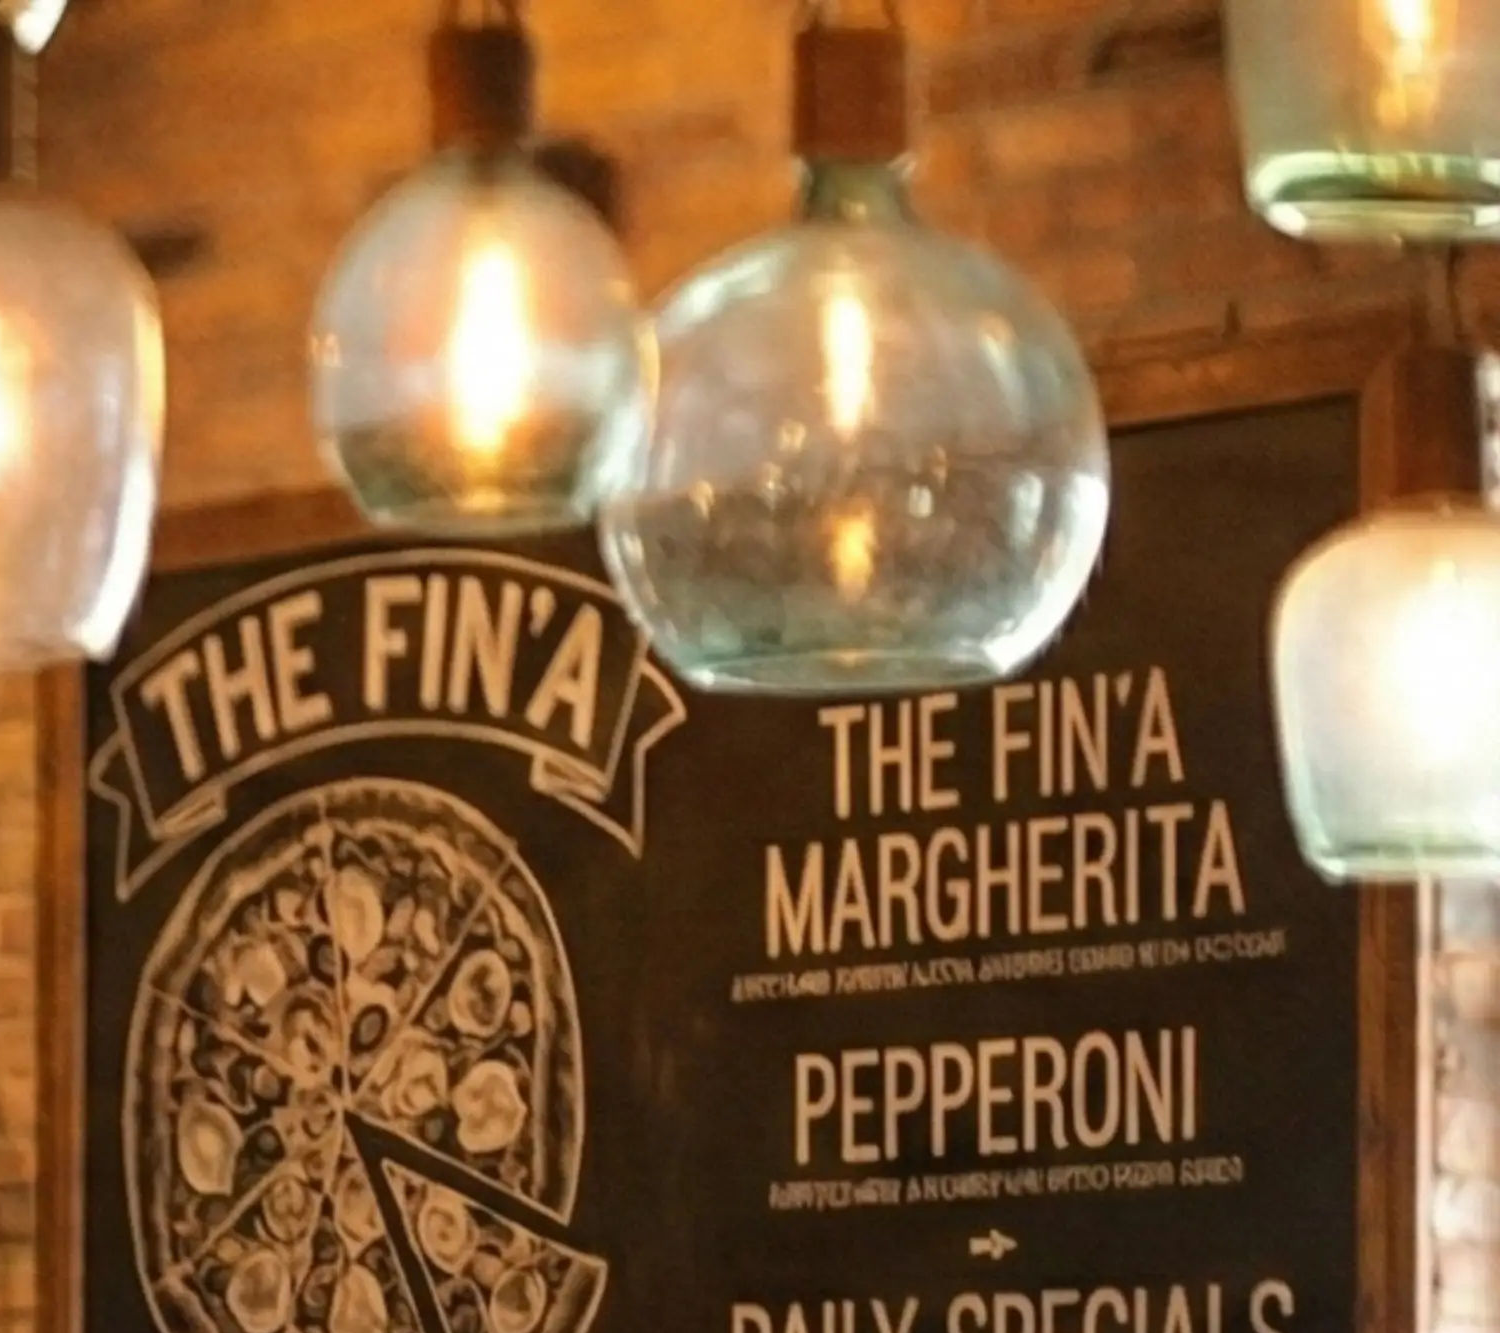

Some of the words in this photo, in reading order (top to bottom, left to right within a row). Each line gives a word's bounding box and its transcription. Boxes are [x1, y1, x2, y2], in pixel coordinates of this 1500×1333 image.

[140, 588, 333, 782] THE
[363, 573, 603, 750] FIN'A
[818, 692, 960, 820] THE
[993, 665, 1185, 802] FIN'A
[763, 799, 1246, 958] MARGHERITA
[794, 1026, 1196, 1165] PEPPERONI
